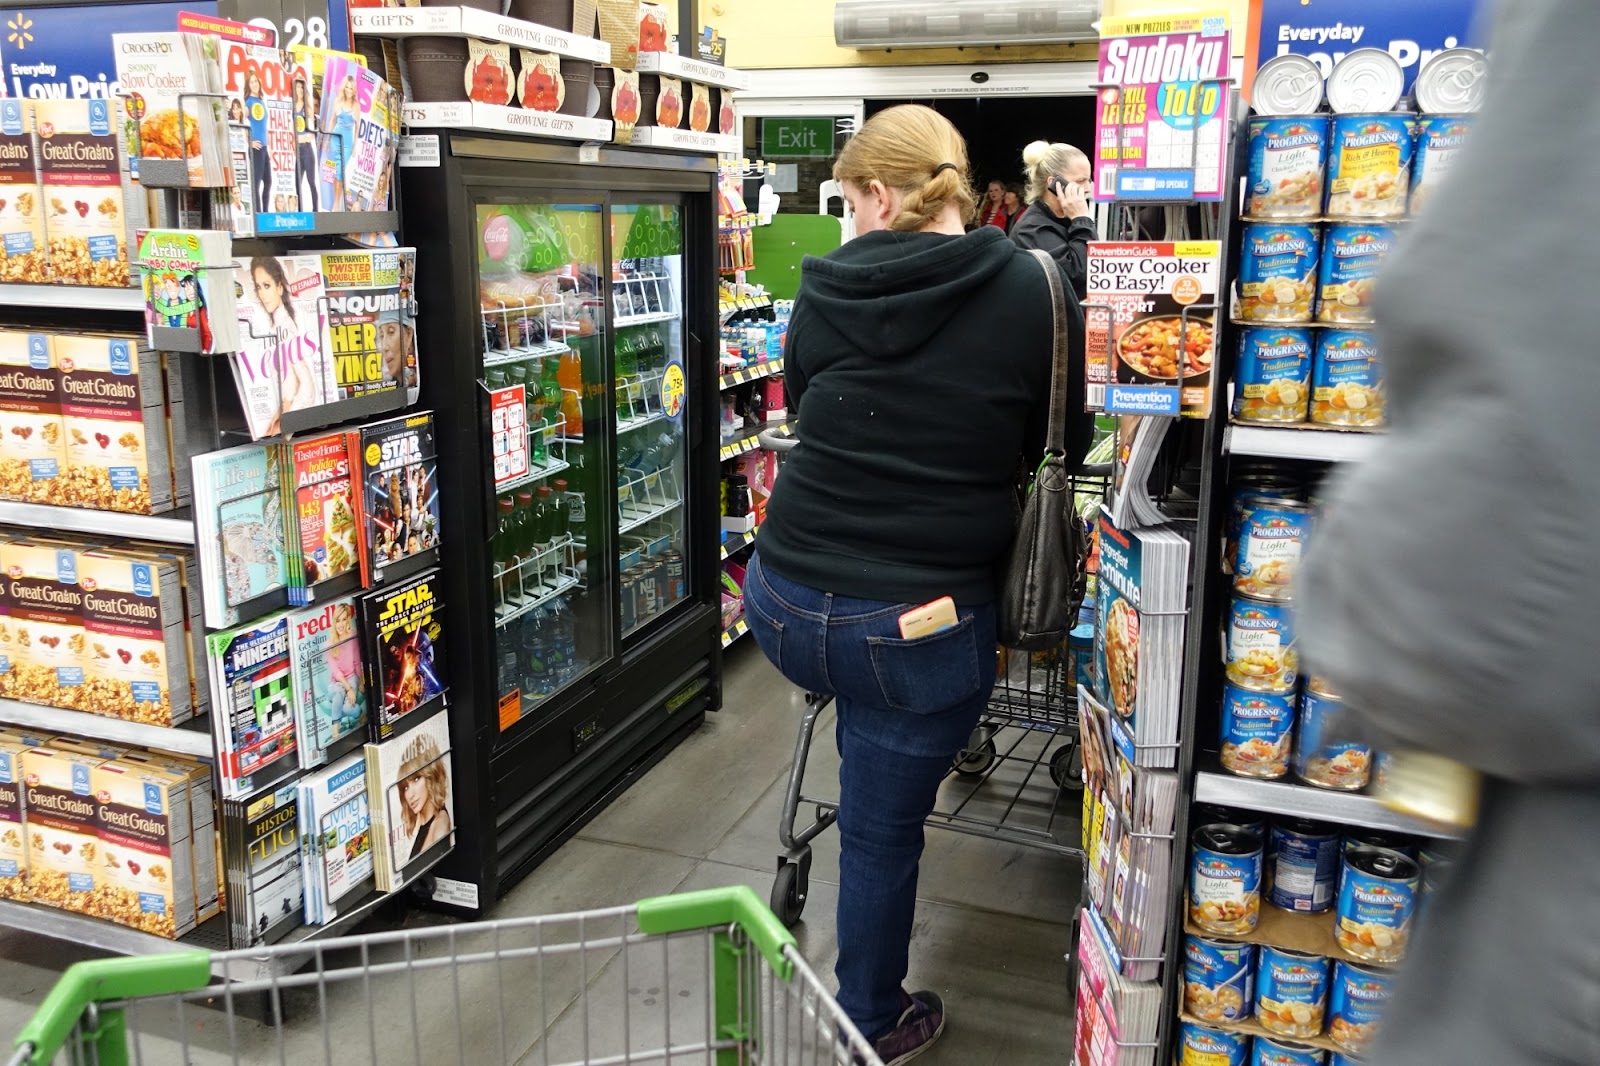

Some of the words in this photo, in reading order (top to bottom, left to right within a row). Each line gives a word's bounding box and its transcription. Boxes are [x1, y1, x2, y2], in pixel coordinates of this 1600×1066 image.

[371, 15, 414, 26] GIFTS
[1126, 23, 1141, 34] NEW
[1143, 21, 1171, 33] PUZZLES
[284, 17, 328, 51] 28
[498, 24, 541, 43] GROWING
[545, 35, 569, 50] GIFTS
[1278, 22, 1364, 45] Everyday
[121, 42, 173, 55] CROCK-POT
[698, 42, 711, 54] Save
[711, 42, 722, 56] $25
[1102, 34, 1223, 85] Sudoku
[11, 62, 57, 77] Everyday
[128, 63, 158, 73] SKINNY
[682, 61, 709, 76] GROWING
[711, 69, 726, 80] GIFTS
[13, 76, 67, 99] Low
[121, 73, 146, 89] Slow
[147, 73, 187, 89] Cooker
[269, 109, 293, 130] HALF
[507, 113, 548, 128] GROWING
[551, 120, 574, 131] GIFTS
[267, 130, 295, 151] THEIR
[358, 118, 384, 148] DIETS
[673, 133, 699, 145] GROWING
[701, 138, 716, 147] GIFTS
[778, 125, 817, 149] Exit
[1268, 133, 1318, 148] PROGRESSO
[1345, 131, 1399, 147] PROGRESSO
[42, 141, 73, 161] Great
[73, 141, 115, 162] Grains
[361, 141, 378, 160] THAT
[1278, 150, 1308, 165] Light
[1345, 152, 1361, 162] Rich
[1362, 150, 1370, 159] &
[1371, 148, 1395, 160] Hearty
[272, 151, 296, 172] SIZE!
[357, 155, 377, 175] WORK
[50, 174, 73, 182] cranberry
[1166, 180, 1188, 189] SPECIALS
[150, 235, 187, 258] Archie
[1254, 240, 1304, 254] PROGRESSO
[1335, 242, 1388, 255] PROGRESSO
[168, 258, 202, 272] COMICS
[327, 255, 343, 263] STEVE
[344, 254, 370, 263] HARVEY'S
[374, 254, 385, 262] 20
[386, 253, 399, 263] BEST
[1257, 256, 1299, 269] Traditional
[1338, 258, 1382, 270] Traditional
[328, 263, 371, 273] TWISTED
[1089, 258, 1134, 275] Slow
[1139, 258, 1211, 275] Cooker
[328, 273, 355, 282] DOUBLE
[356, 272, 372, 281] LIFE!
[374, 270, 398, 279] BEACH
[1089, 276, 1111, 290] So
[1115, 275, 1165, 293] Easy!
[330, 323, 377, 353] HER
[239, 314, 326, 385] Vegas!
[1258, 343, 1306, 356] PROGRESSO
[1326, 348, 1377, 360] PROGRESSO
[334, 352, 383, 384] YING!
[1262, 359, 1301, 372] Traditional
[1328, 363, 1371, 375] Traditional
[14, 372, 55, 392] Grains
[62, 375, 93, 395] Great
[95, 378, 136, 399] Grains
[673, 378, 683, 389] 75¢
[1112, 388, 1172, 403] Prevention
[1, 403, 20, 411] crunchy
[69, 406, 92, 415] cranberry
[92, 408, 112, 416] almond
[1112, 401, 1171, 411] PreventionGuide
[295, 447, 316, 462] Taste
[320, 444, 342, 457] Home
[381, 435, 420, 461] STAR
[211, 456, 242, 468] COLORING
[308, 457, 338, 473] holiday
[214, 464, 244, 489] Life
[246, 466, 260, 477] on
[312, 488, 321, 499] &
[300, 500, 320, 518] 143
[301, 514, 320, 525] PARTY
[301, 519, 324, 532] RECIPES
[1252, 526, 1301, 537] PROGRESSO
[1259, 541, 1287, 553] Light
[421, 575, 435, 584] EDITION
[11, 582, 42, 600] Great
[43, 585, 82, 605] Grains
[85, 594, 117, 613] Great
[117, 598, 157, 618] Grains
[379, 583, 433, 621] STAR
[376, 618, 388, 628] THE
[390, 609, 411, 624] FORCE
[411, 597, 437, 613] AWAKENS
[1234, 617, 1278, 629] PROGRESSO
[236, 642, 249, 651] THE
[250, 632, 275, 647] ULTIMATE
[299, 640, 311, 652] Get
[312, 634, 327, 646] slim
[1239, 632, 1265, 642] Light
[1232, 705, 1279, 717] PROGRESSO
[1235, 720, 1273, 729] Traditional
[1231, 729, 1248, 737] Chicken
[331, 770, 352, 789] MAYO
[333, 780, 362, 804] Solutions
[28, 788, 57, 808] Great
[57, 794, 94, 816] Grains
[99, 805, 128, 828] Great
[129, 812, 166, 837] Grains
[256, 805, 297, 837] HISTOR
[323, 798, 360, 832] Living
[1197, 865, 1241, 878] PROGRESSO
[1204, 880, 1229, 891] Light
[1355, 889, 1403, 903] PROGRESSO
[1356, 904, 1396, 915] Traditional
[1273, 969, 1320, 983] PROGRESSO
[1275, 983, 1314, 993] Traditional
[1185, 1037, 1228, 1053] PROGRESSO
